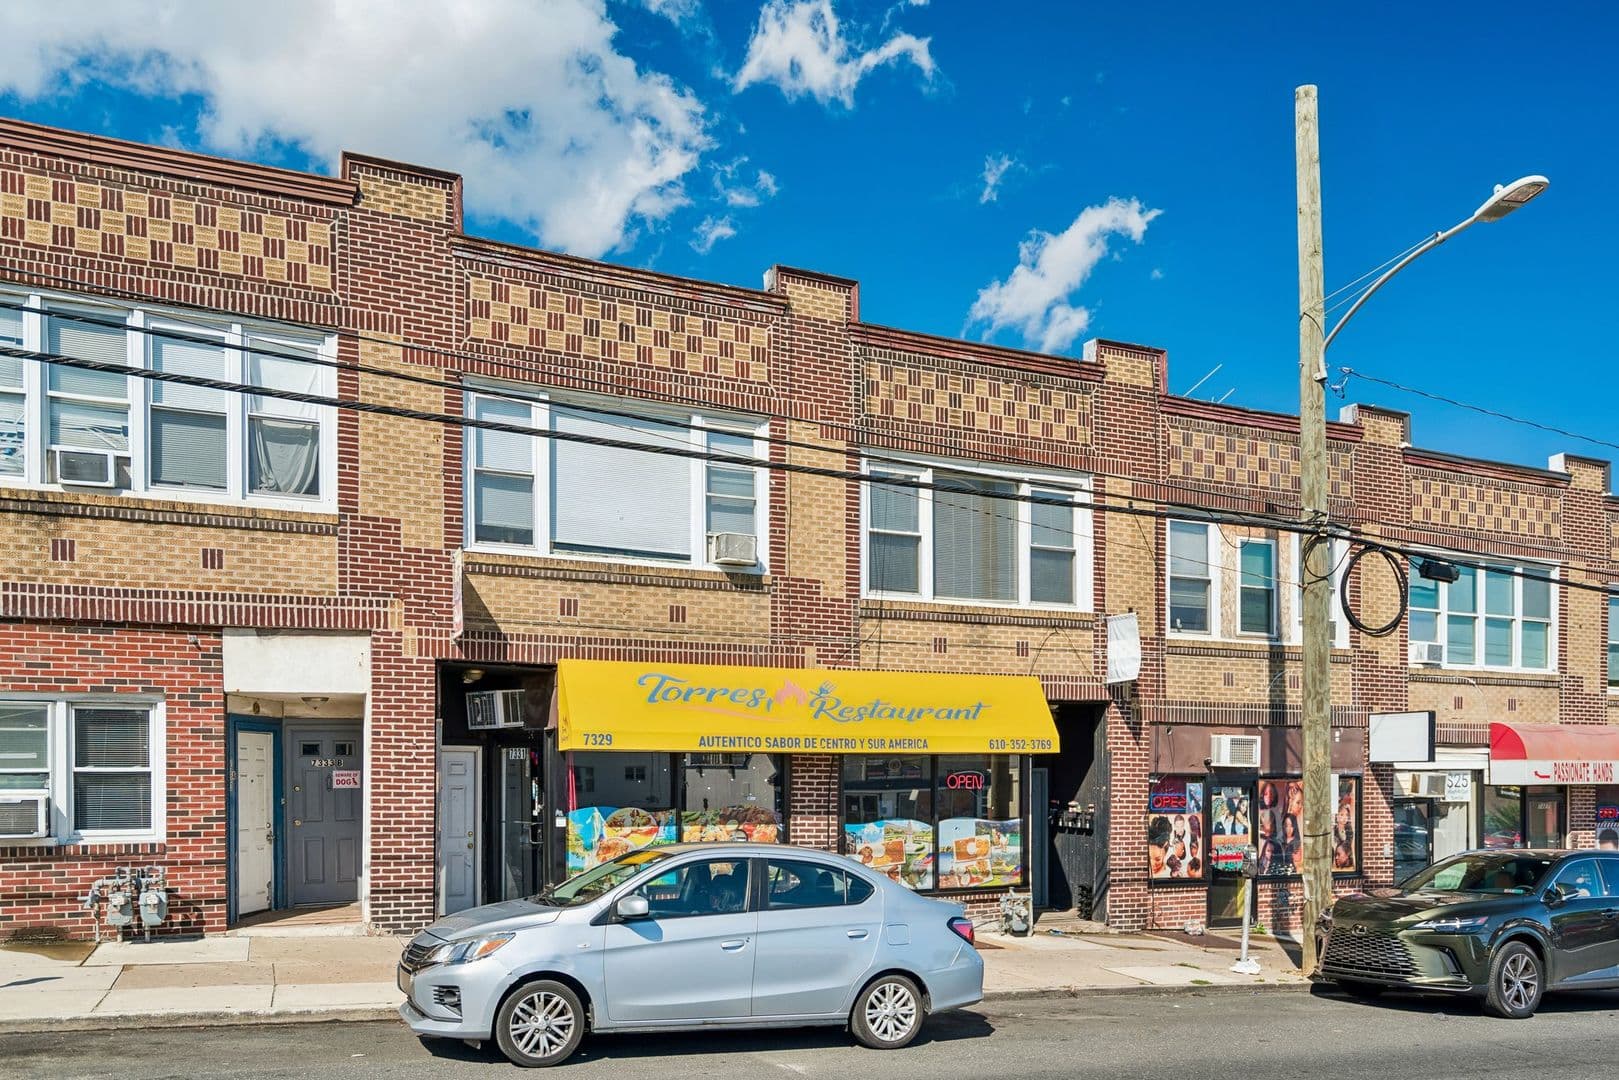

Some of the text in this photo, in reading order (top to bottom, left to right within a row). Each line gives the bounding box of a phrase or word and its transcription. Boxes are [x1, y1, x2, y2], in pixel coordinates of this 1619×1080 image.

[637, 672, 766, 708] Torres
[809, 696, 992, 723] Restaurant
[583, 733, 613, 745] 7329
[699, 735, 929, 749] AUTENTICO SABOR DE CENTRO Y SUR AMERICA
[989, 739, 1052, 750] 610-352-3769
[1553, 762, 1614, 782] PASSIONATE HANDS
[946, 774, 983, 790] OPEN
